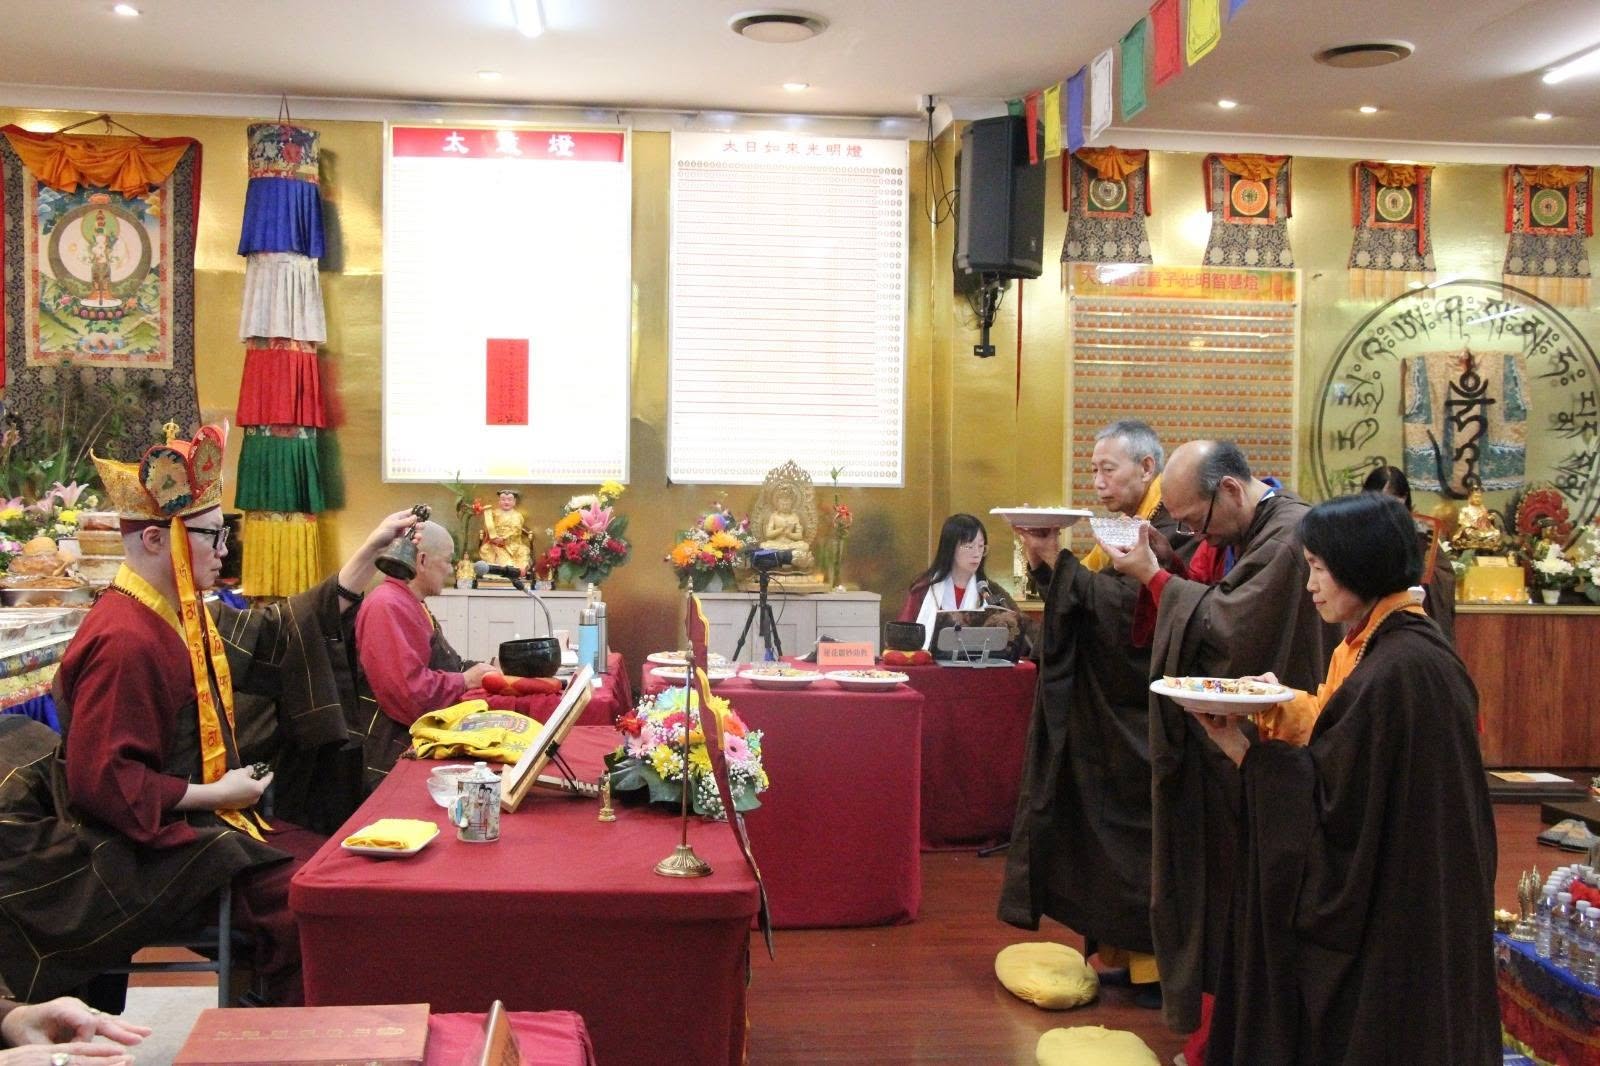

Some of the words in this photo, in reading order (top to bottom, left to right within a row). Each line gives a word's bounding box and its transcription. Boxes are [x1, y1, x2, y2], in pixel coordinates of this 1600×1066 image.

[1081, 269, 1259, 291] 大蓮花童子光明智慧燈
